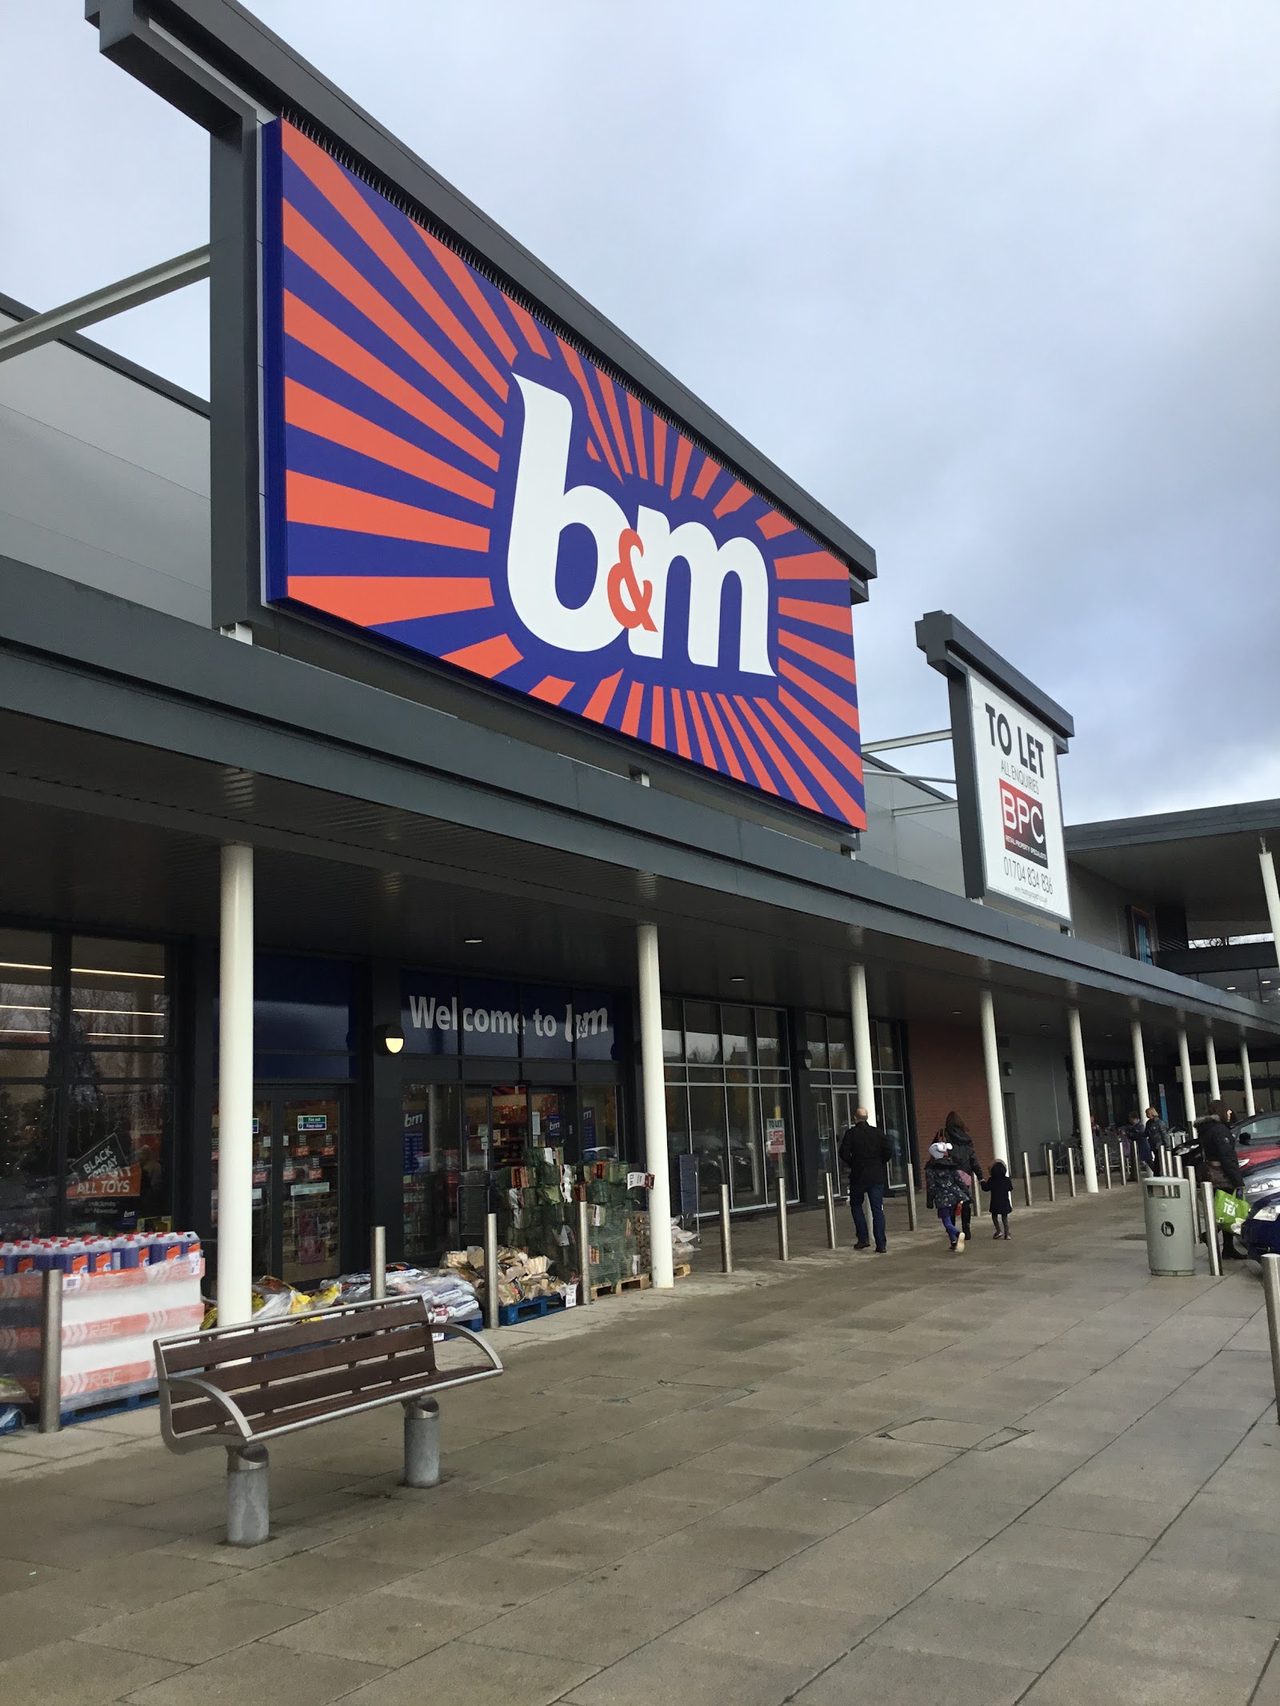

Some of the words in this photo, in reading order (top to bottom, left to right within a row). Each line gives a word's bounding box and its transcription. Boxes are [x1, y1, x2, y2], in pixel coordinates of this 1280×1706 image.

[507, 372, 777, 677] b&m
[985, 702, 1012, 756] TO
[1017, 726, 1044, 779] LET
[1001, 787, 1044, 844] BPC
[1003, 856, 1026, 882] 01704
[1027, 867, 1040, 888] 834
[409, 995, 526, 1035] Welcome
[533, 1008, 557, 1037] to
[83, 1145, 113, 1174] BLACK
[77, 1181, 97, 1194] ALL
[101, 1180, 130, 1193] TOYS
